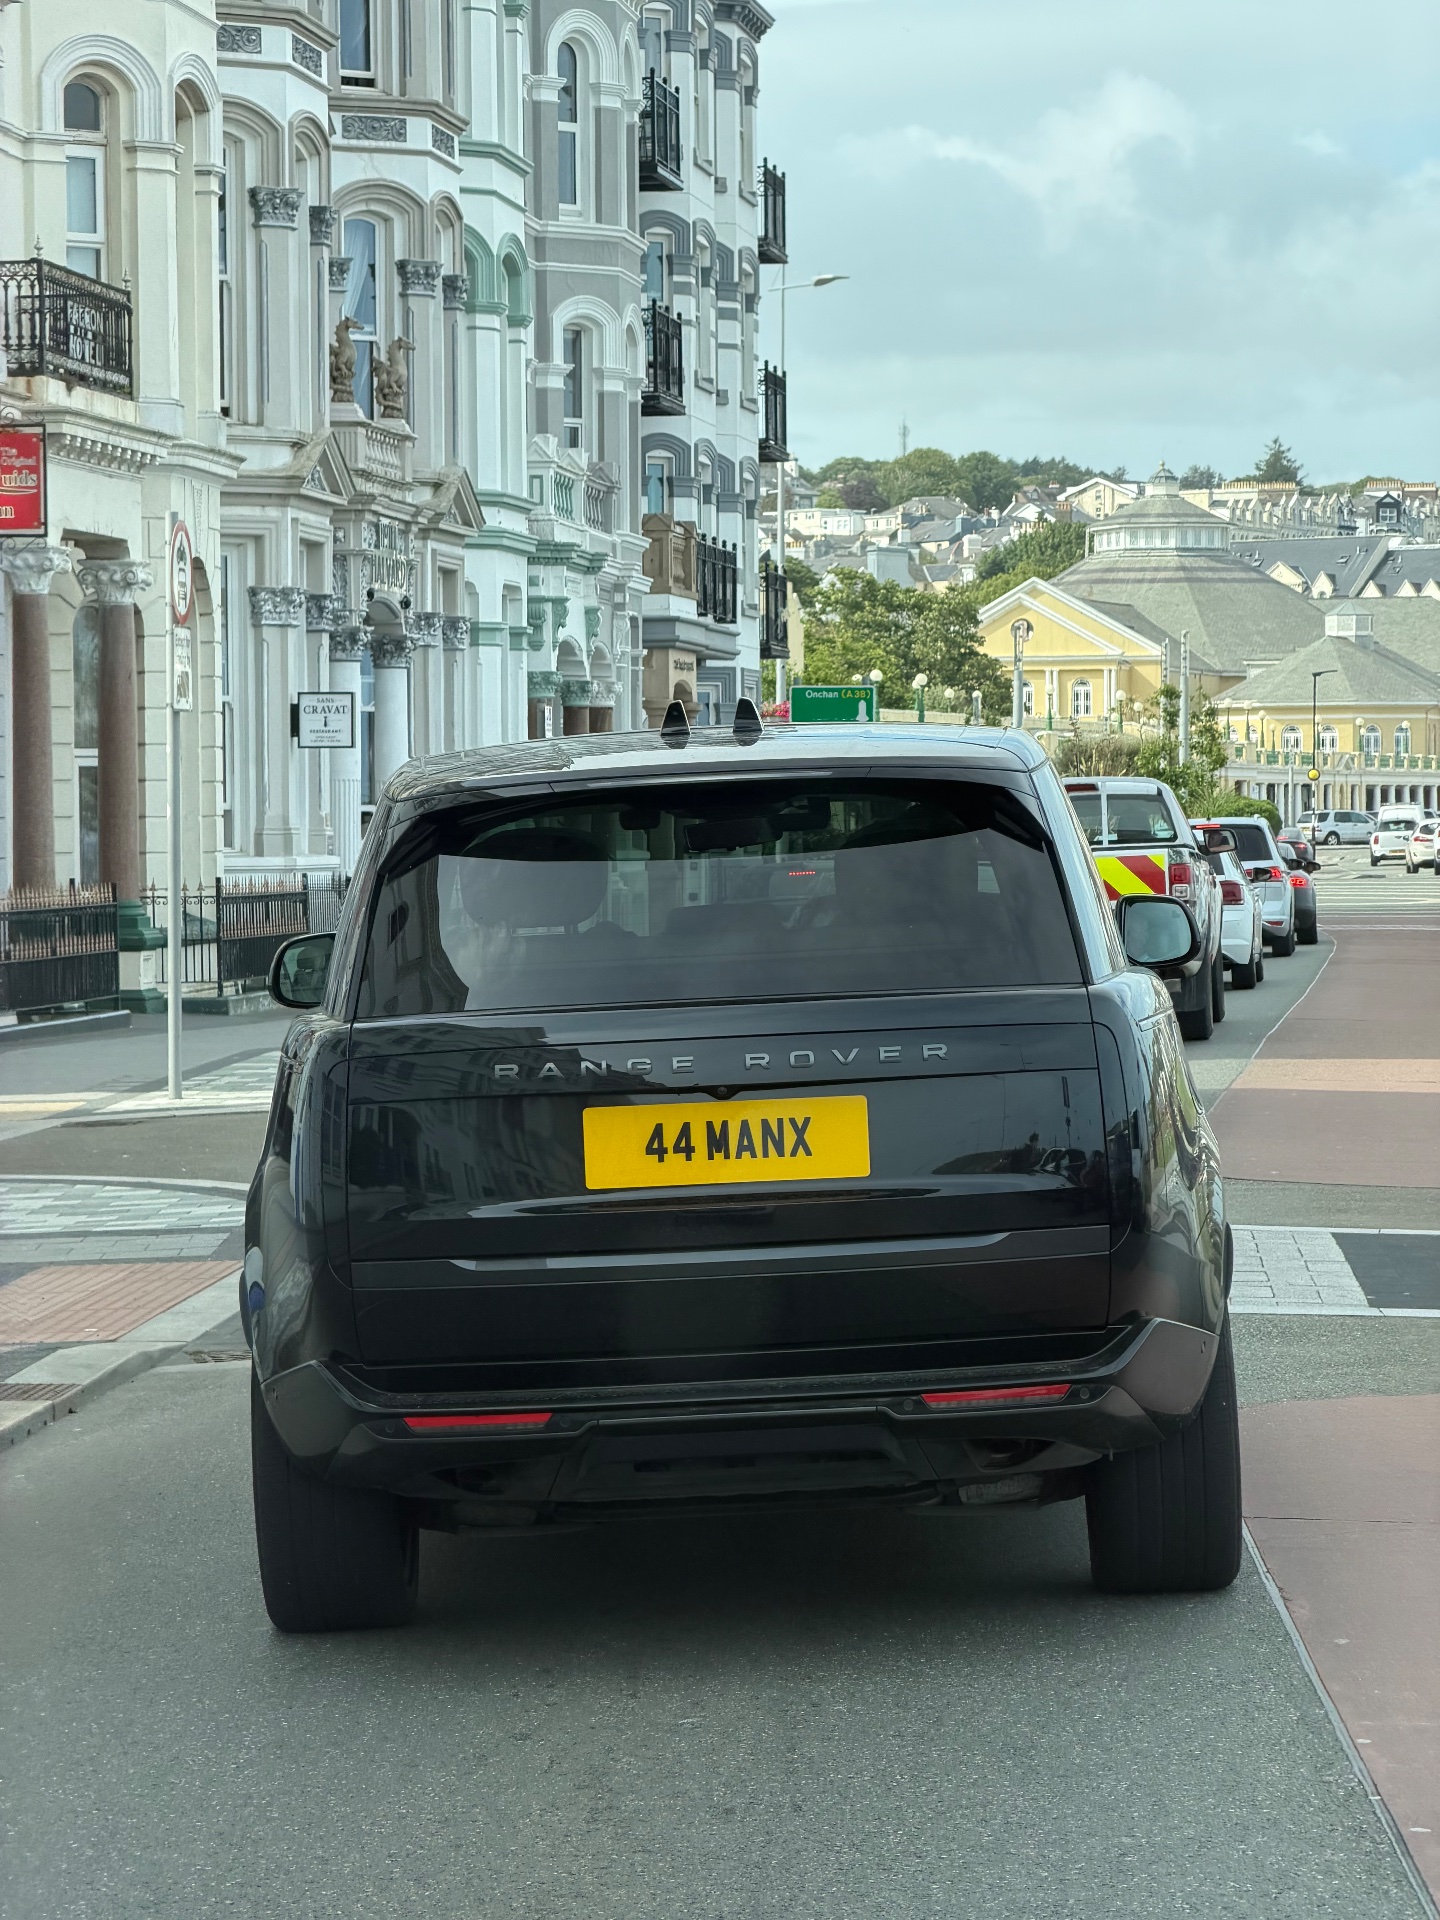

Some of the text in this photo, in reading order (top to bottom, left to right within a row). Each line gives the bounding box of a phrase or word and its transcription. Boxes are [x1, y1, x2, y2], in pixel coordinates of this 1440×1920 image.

[69, 334, 102, 366] HOTEL
[1, 456, 36, 467] Original
[0, 469, 37, 487] uids
[372, 554, 406, 589] HALYARD
[805, 689, 839, 699] Onchan
[303, 704, 348, 715] CRAVAT
[494, 1043, 949, 1080] RANGE ROVER
[645, 1116, 813, 1163] 44 MANX
